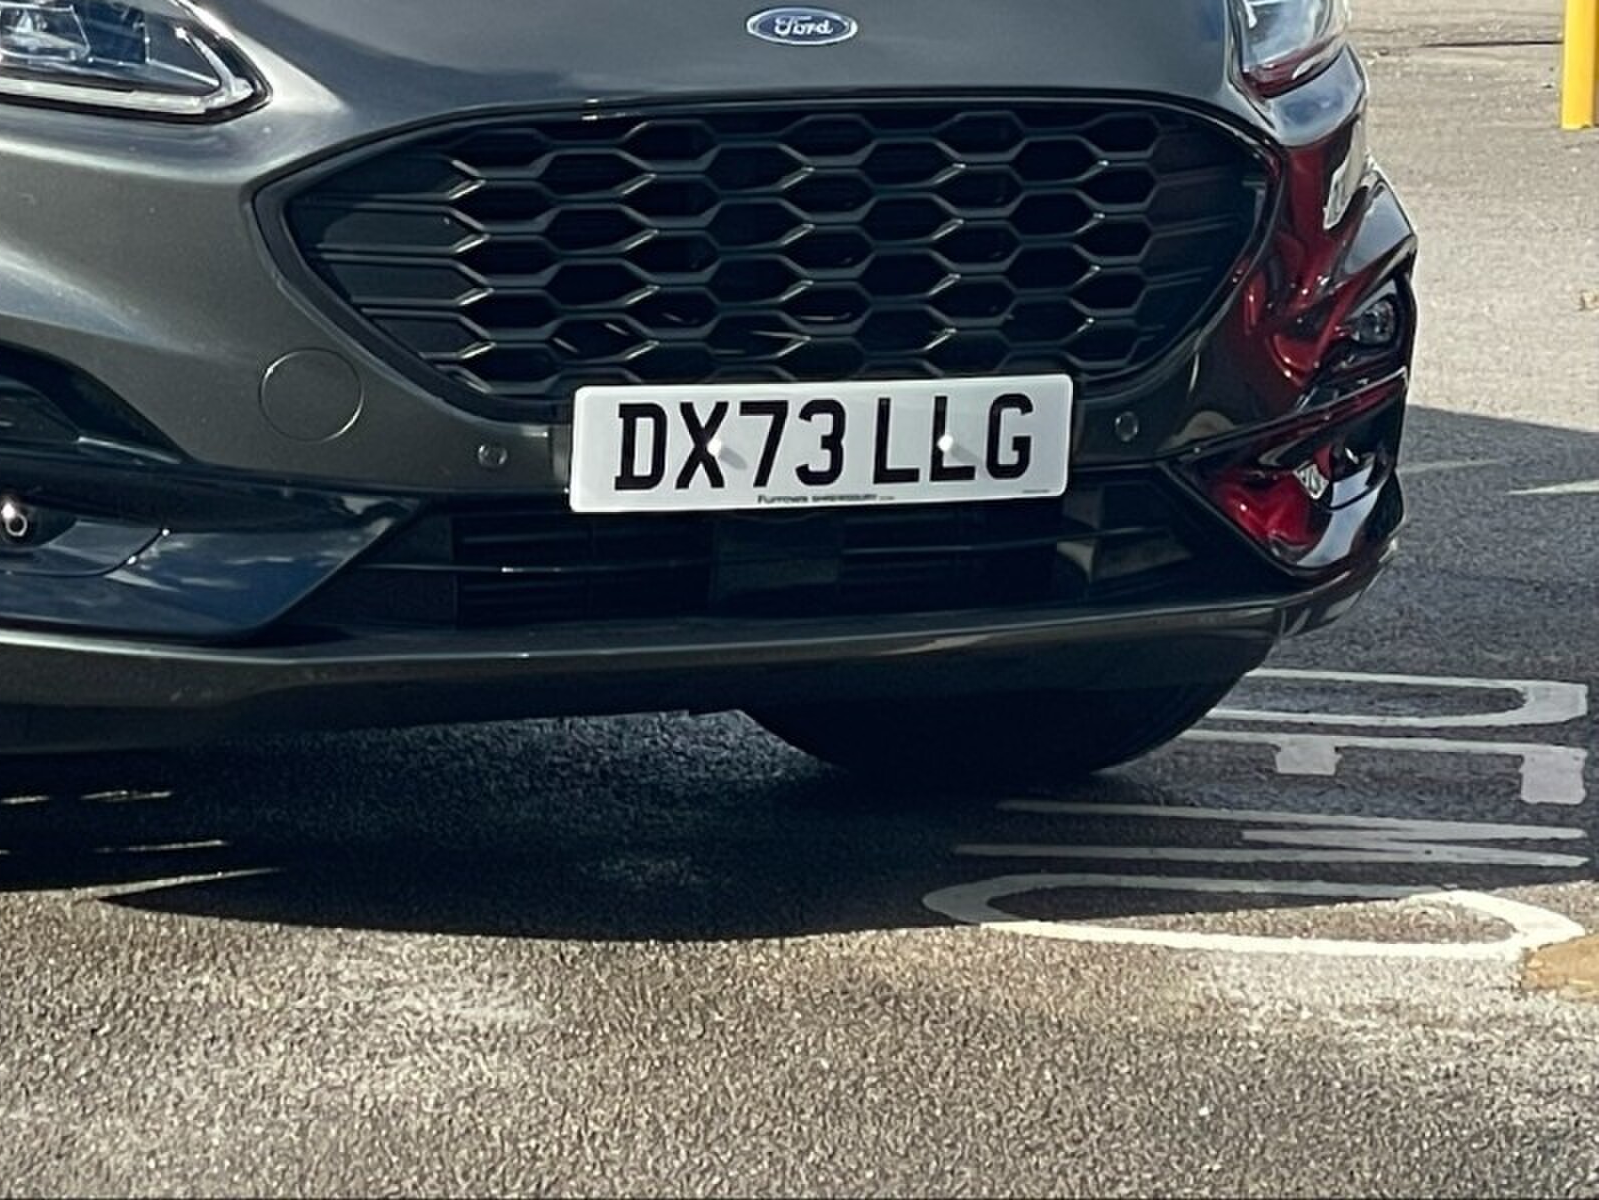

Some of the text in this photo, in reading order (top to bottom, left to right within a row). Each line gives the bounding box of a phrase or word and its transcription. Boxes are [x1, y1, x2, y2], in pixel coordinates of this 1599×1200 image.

[775, 15, 833, 36] Ford
[613, 393, 1034, 491] DX73 LLG
